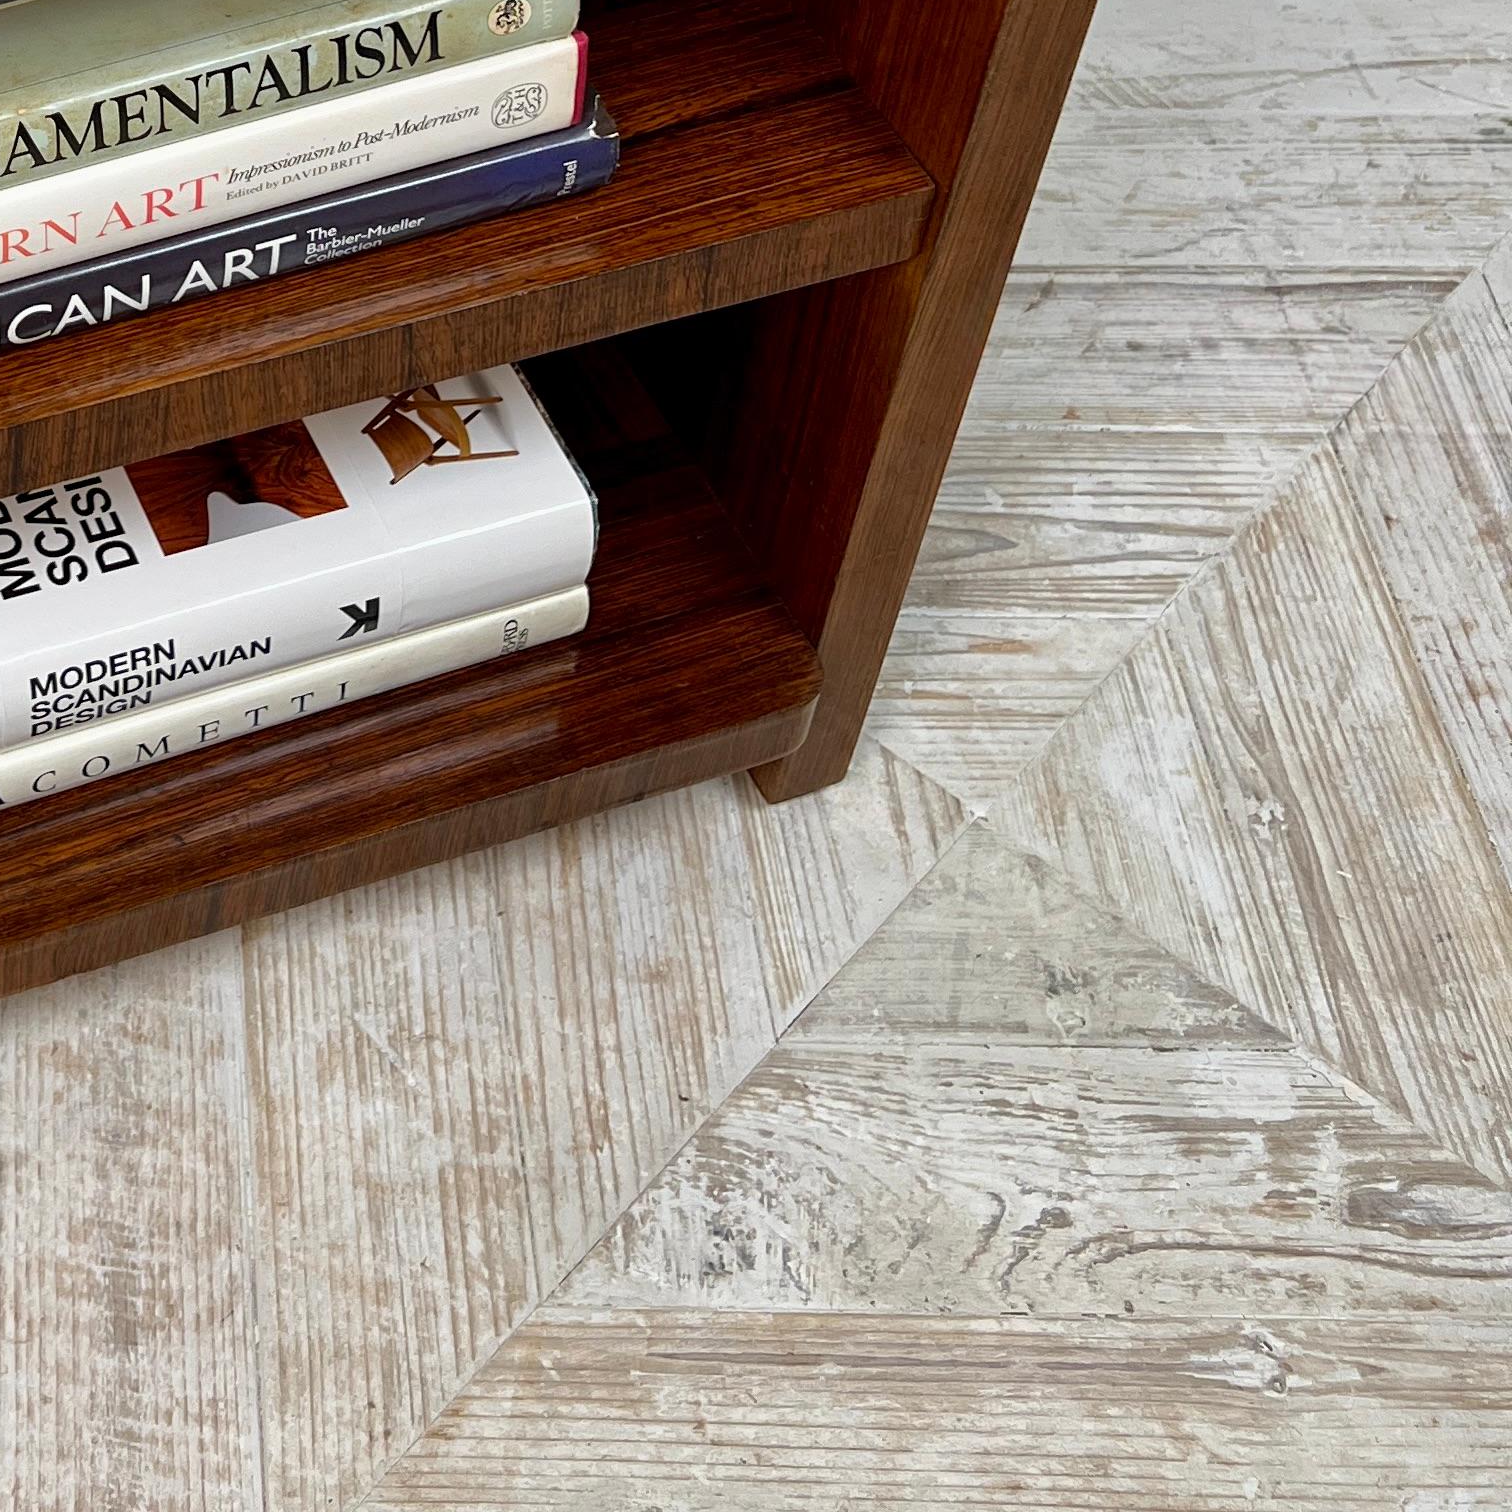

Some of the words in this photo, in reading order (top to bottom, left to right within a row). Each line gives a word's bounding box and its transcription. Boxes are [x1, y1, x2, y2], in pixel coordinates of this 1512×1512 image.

[227, 145, 336, 185] Impressionism
[337, 138, 352, 153] to
[354, 105, 480, 150] Post-Modernism
[96, 173, 219, 239] ART
[226, 181, 263, 201] Edited
[265, 175, 280, 190] by
[281, 164, 328, 186] DAVID
[330, 152, 374, 173] BRITT
[304, 238, 383, 265] Collection
[306, 225, 338, 243] The
[306, 216, 426, 255] Barbier-Mueller
[171, 234, 297, 302] ART
[63, 476, 140, 573] DESI
[30, 639, 175, 700] MODERN
[30, 637, 272, 720] SCANDINAVIAN
[30, 690, 152, 737] DESIGN
